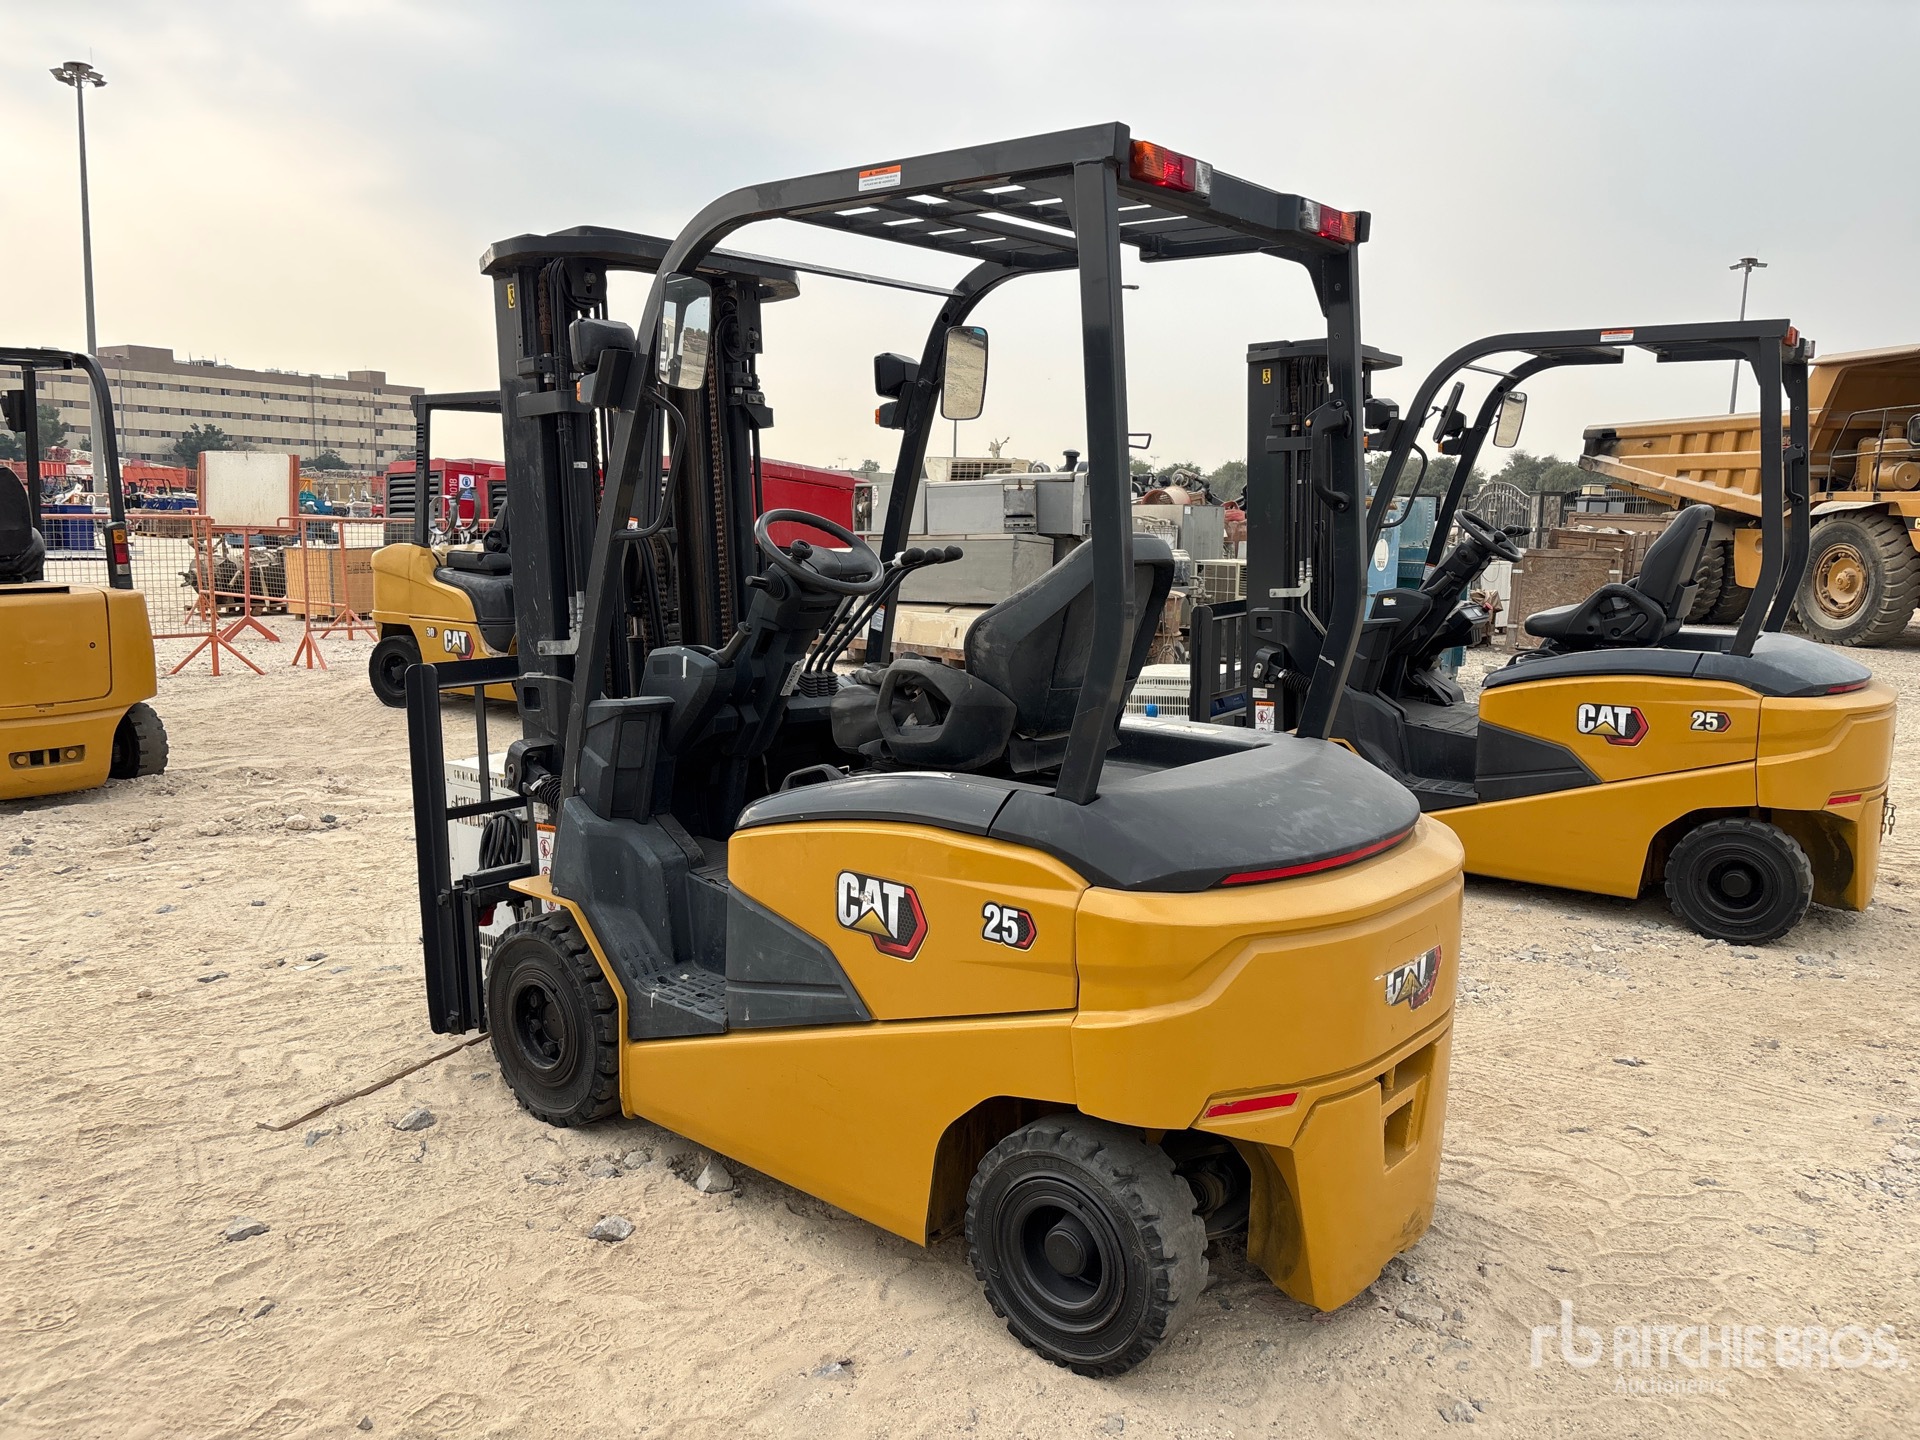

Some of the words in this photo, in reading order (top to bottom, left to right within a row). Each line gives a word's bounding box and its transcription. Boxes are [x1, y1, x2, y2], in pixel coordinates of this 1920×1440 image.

[443, 629, 467, 654] CAT
[1578, 703, 1631, 736] CAT
[1692, 712, 1719, 731] 25
[838, 872, 905, 939] CAT
[983, 904, 1019, 944] 25
